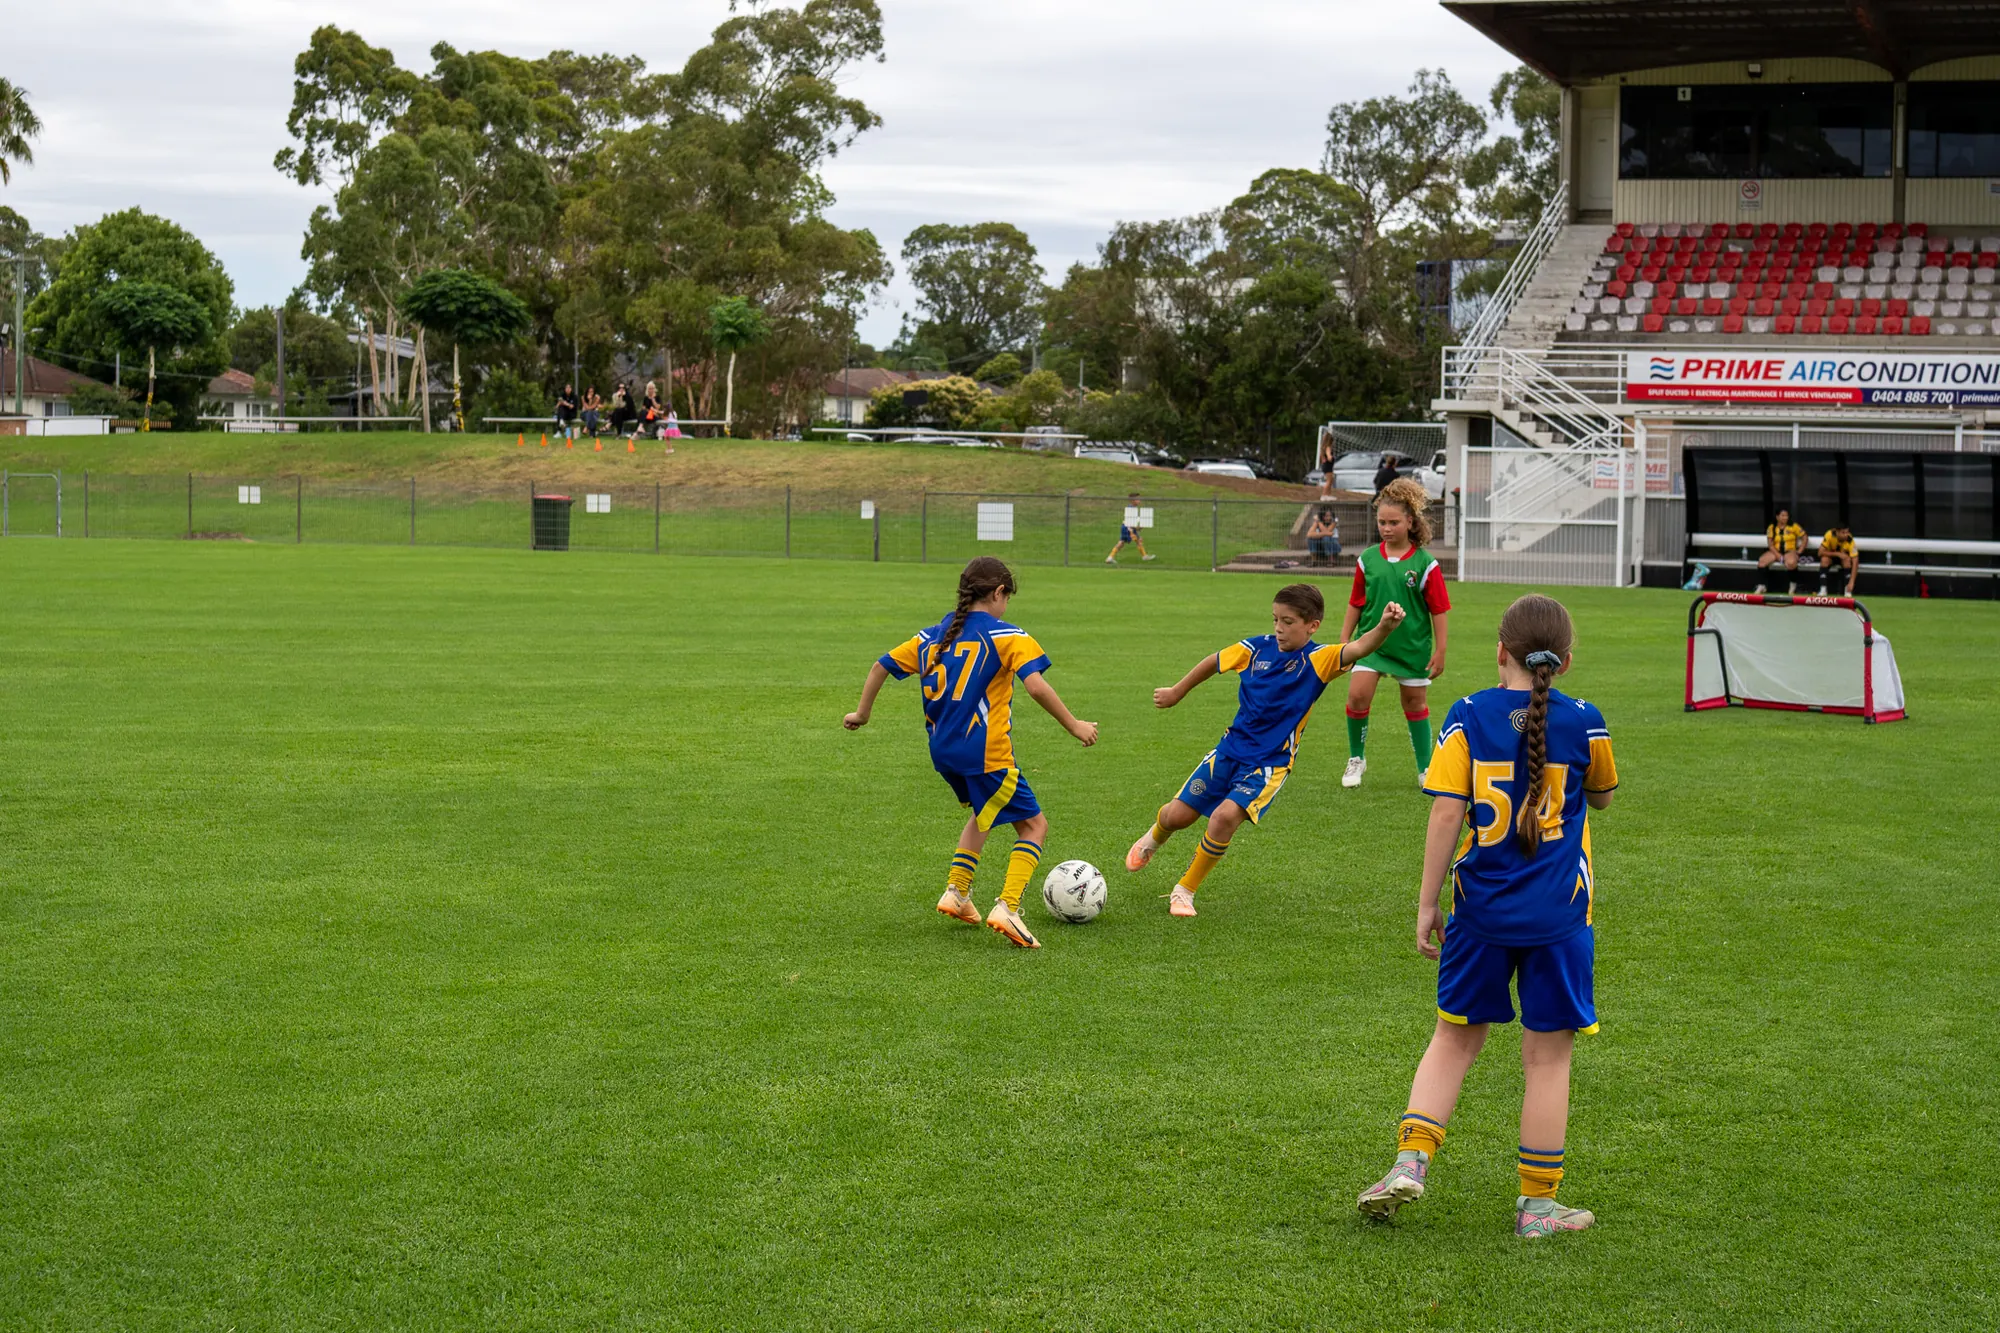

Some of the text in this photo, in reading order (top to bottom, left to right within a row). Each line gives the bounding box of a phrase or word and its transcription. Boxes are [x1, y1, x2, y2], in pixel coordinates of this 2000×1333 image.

[1680, 359, 2000, 385] PRIME AIRCONDITIONI
[1648, 388, 1853, 401] SPLIT DUCTED ELECTRICAL MAINTENANCE SERVICE VENTILATION
[1871, 390, 1902, 403] 0404
[1904, 391, 1928, 404] 885
[1931, 391, 1954, 404] 700
[923, 641, 981, 701] 57
[1473, 759, 1569, 847] 54
